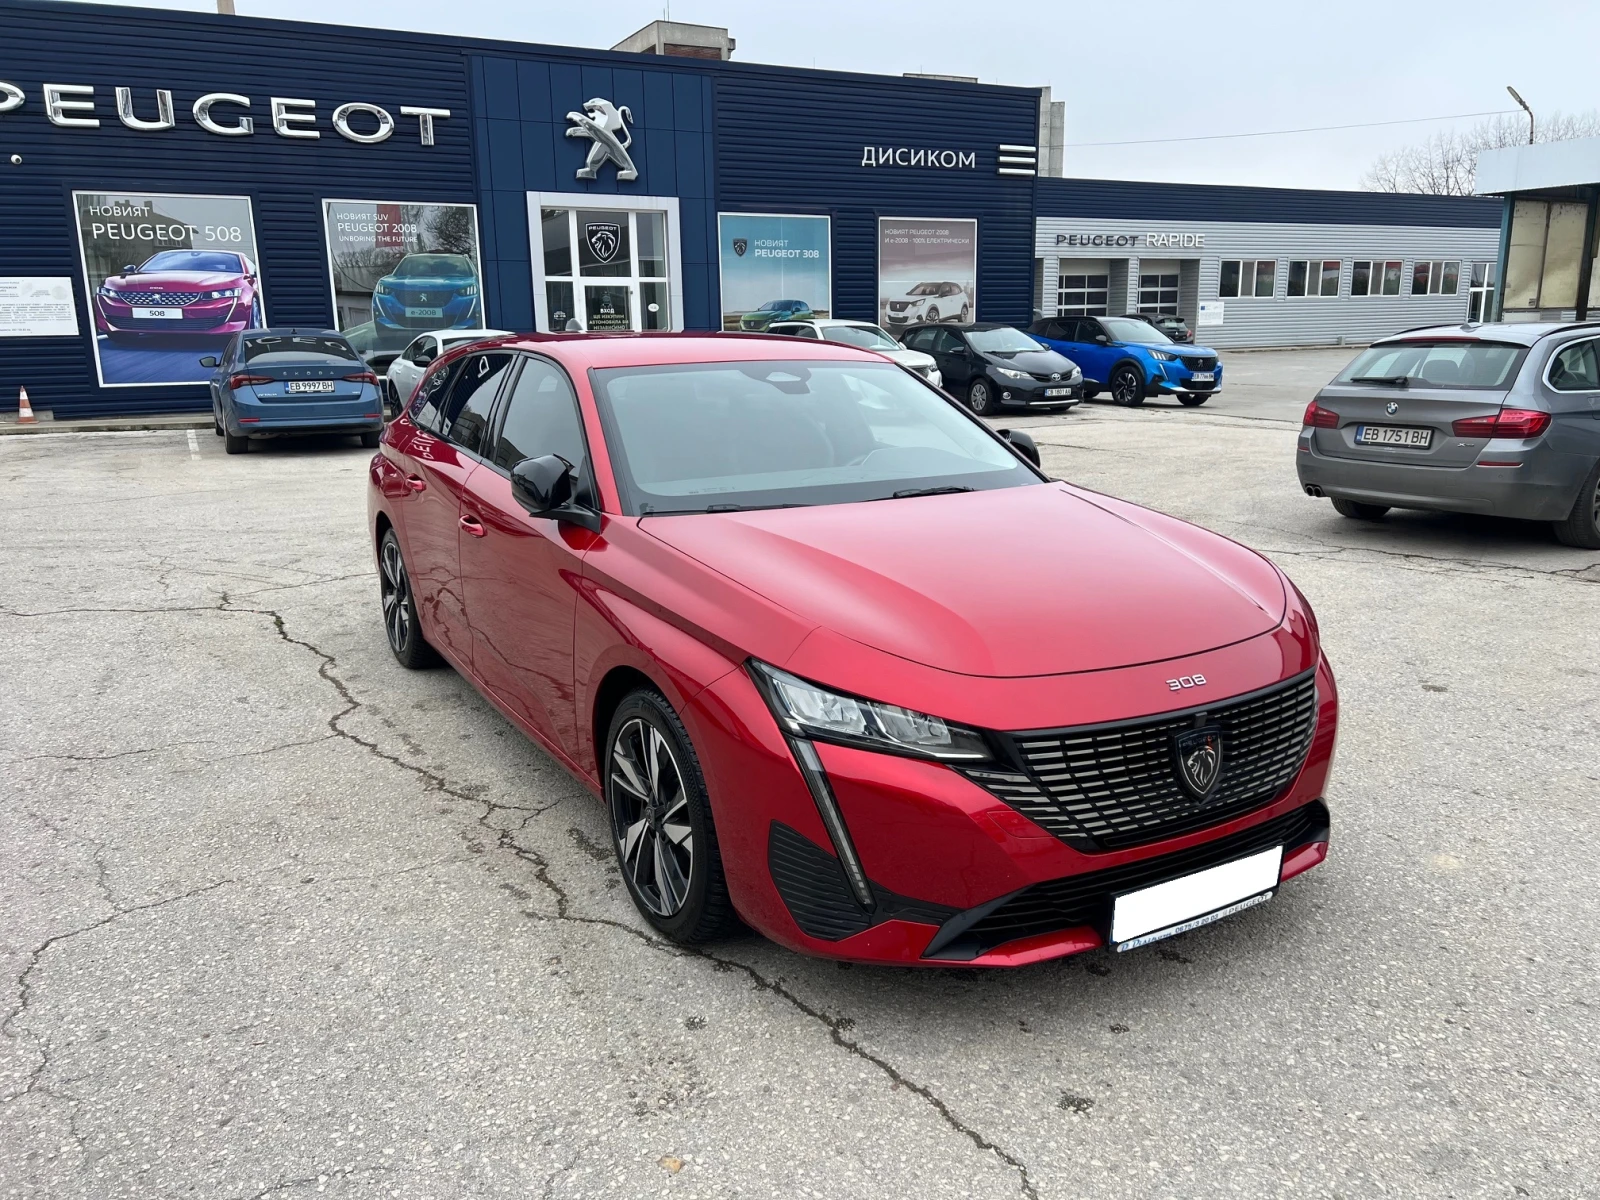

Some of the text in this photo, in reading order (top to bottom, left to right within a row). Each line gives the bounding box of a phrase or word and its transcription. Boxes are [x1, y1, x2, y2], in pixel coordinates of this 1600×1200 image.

[861, 146, 976, 168] ДИСИКОМ
[89, 205, 150, 217] НОВИЯТ
[336, 213, 389, 221] НОВИЯТ SUV
[92, 223, 242, 242] PEUGEOT 508
[337, 223, 417, 233] PEUGEOT 2008
[754, 239, 789, 247] НОВИЯТ
[1055, 233, 1206, 247] PEUGEOT RAPIDE
[754, 249, 820, 258] PEUGEOT 308
[290, 381, 333, 391] EB 9997 BH
[1363, 428, 1429, 444] EB 1751 BH
[1165, 674, 1207, 691] 308
[1228, 894, 1270, 915] PEUGEOT
